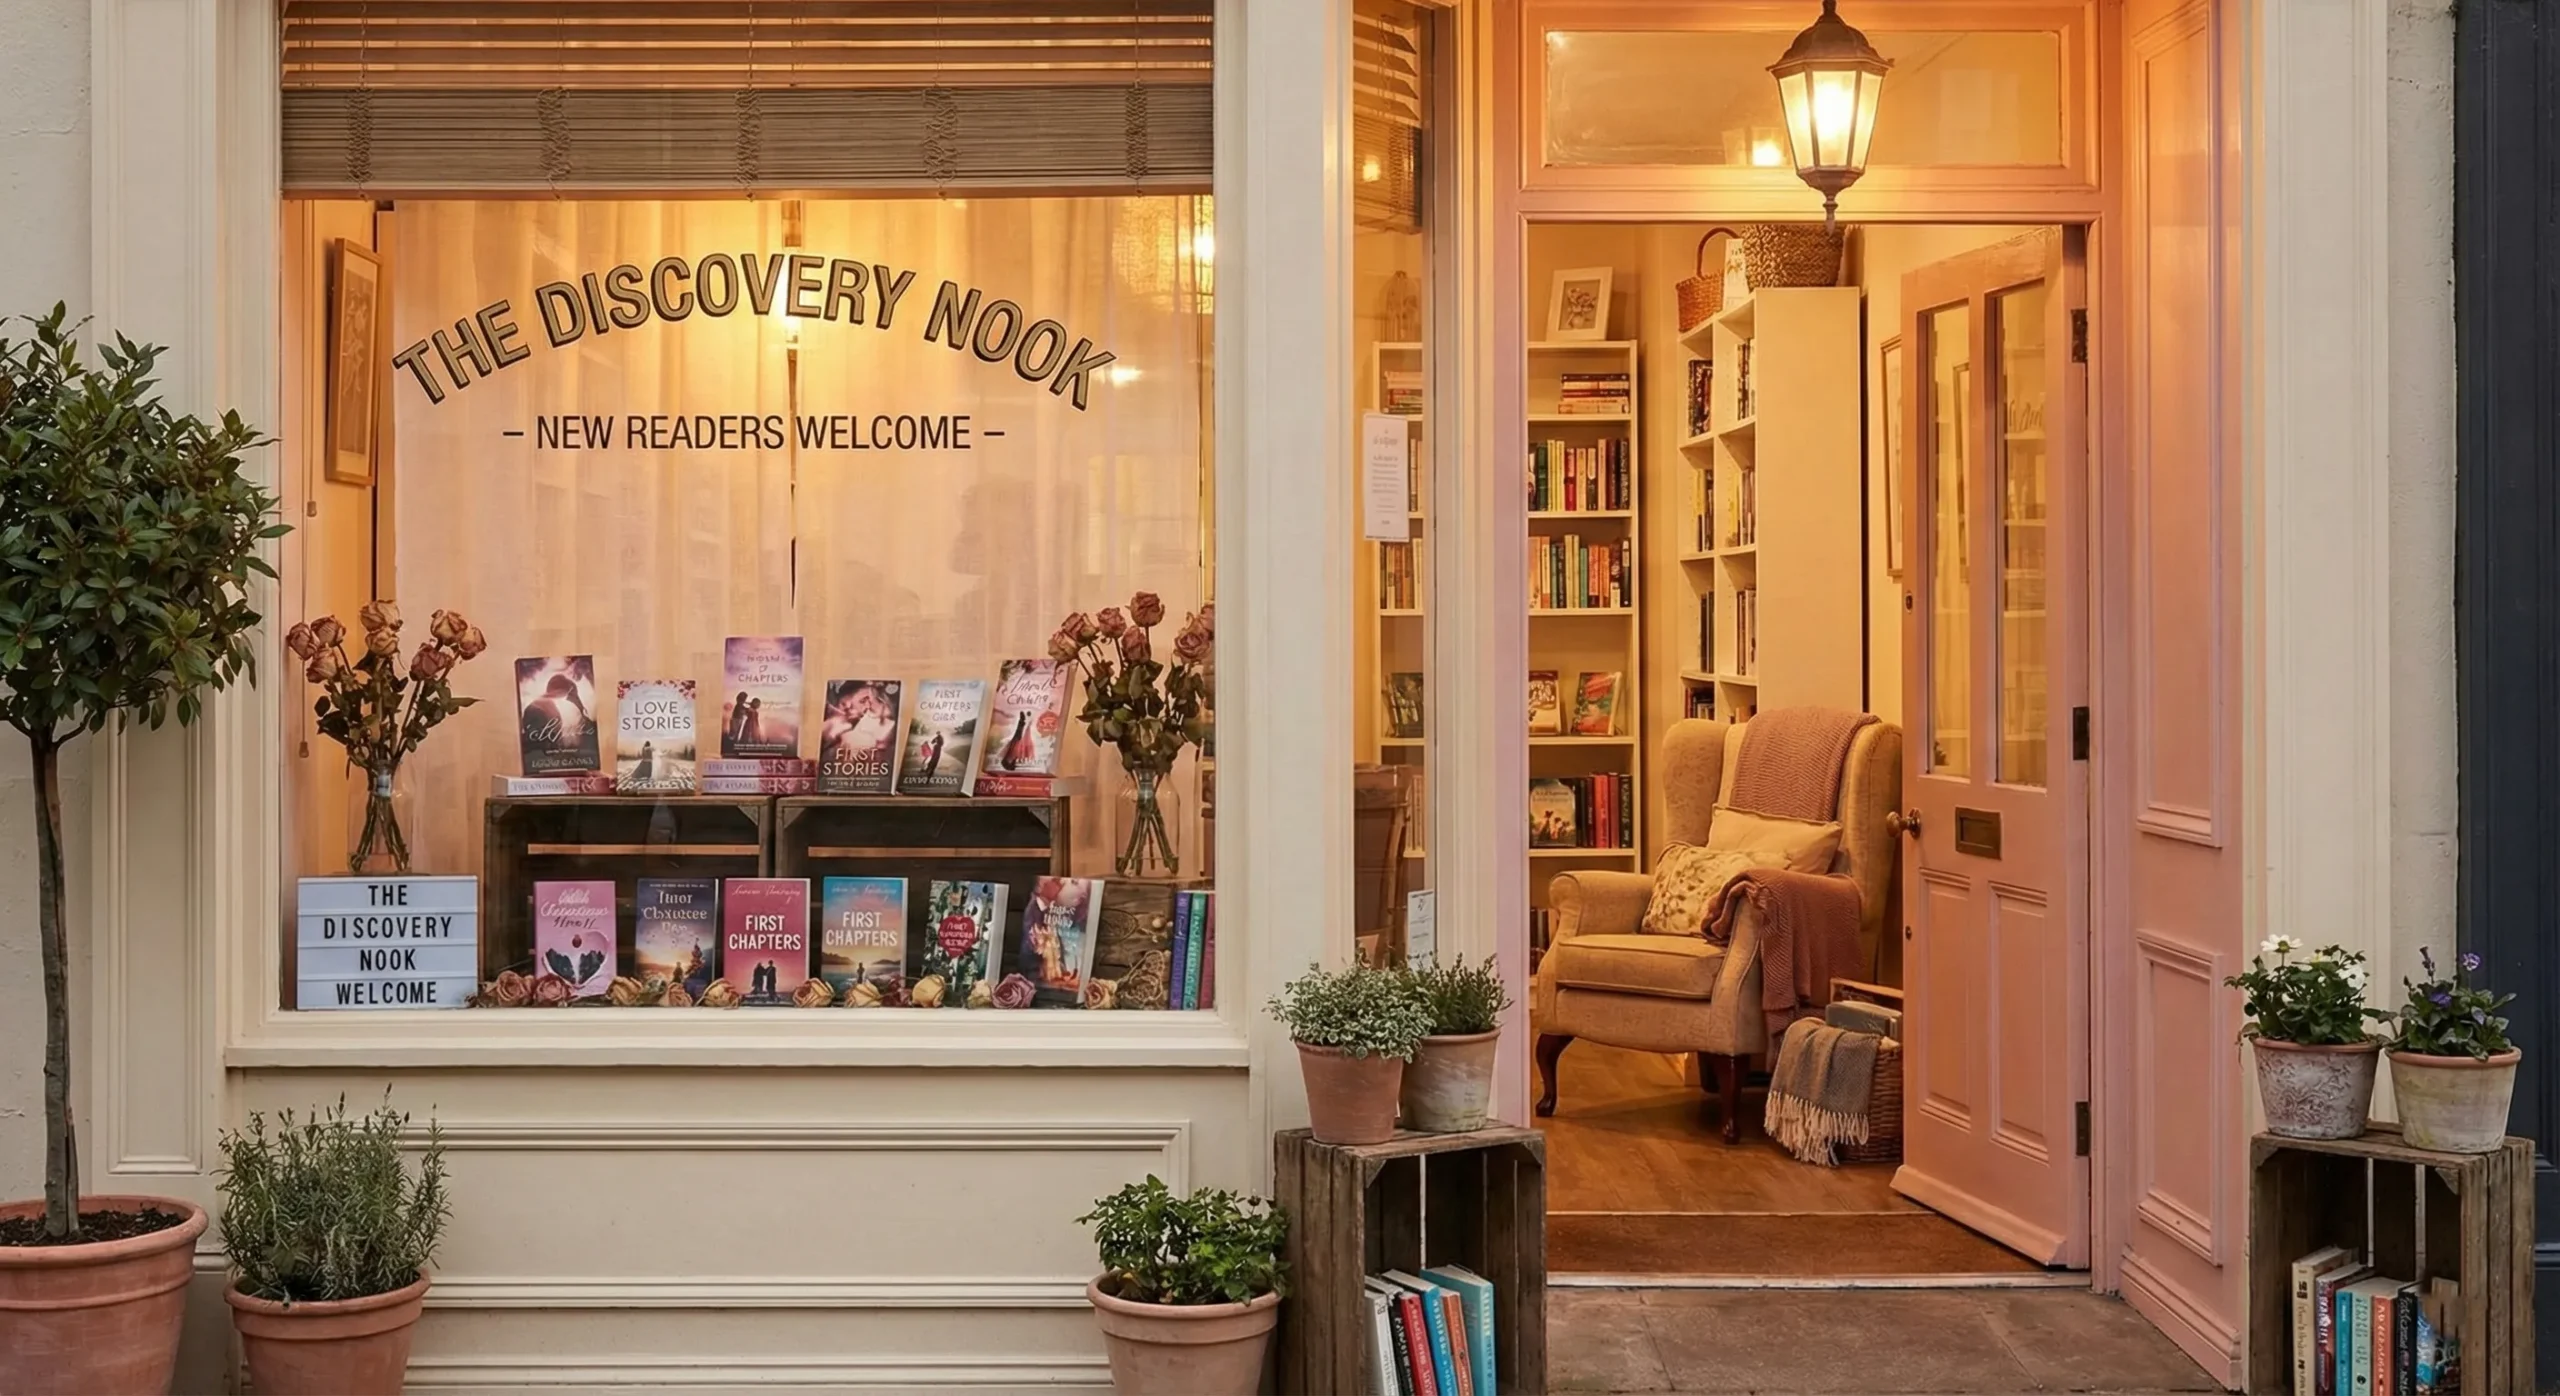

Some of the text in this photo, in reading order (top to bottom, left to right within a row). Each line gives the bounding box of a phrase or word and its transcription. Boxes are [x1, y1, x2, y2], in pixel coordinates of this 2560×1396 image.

[391, 252, 1117, 412] THE DISCOVERY NOOK
[536, 415, 971, 449] NEW READERS WELCOME
[635, 701, 678, 715] LOVE
[622, 716, 691, 731] STORIES
[836, 748, 878, 761] FIRST
[823, 762, 889, 775] STORIES
[368, 884, 408, 906] THE
[324, 916, 452, 939] DISCOVERY
[745, 914, 785, 931] FIRST
[842, 911, 882, 928] FIRST
[729, 933, 801, 950] CHAPTERS
[826, 929, 898, 947] CHAPTERS
[360, 949, 416, 971] NOOK
[336, 981, 437, 1005] WELCOME
